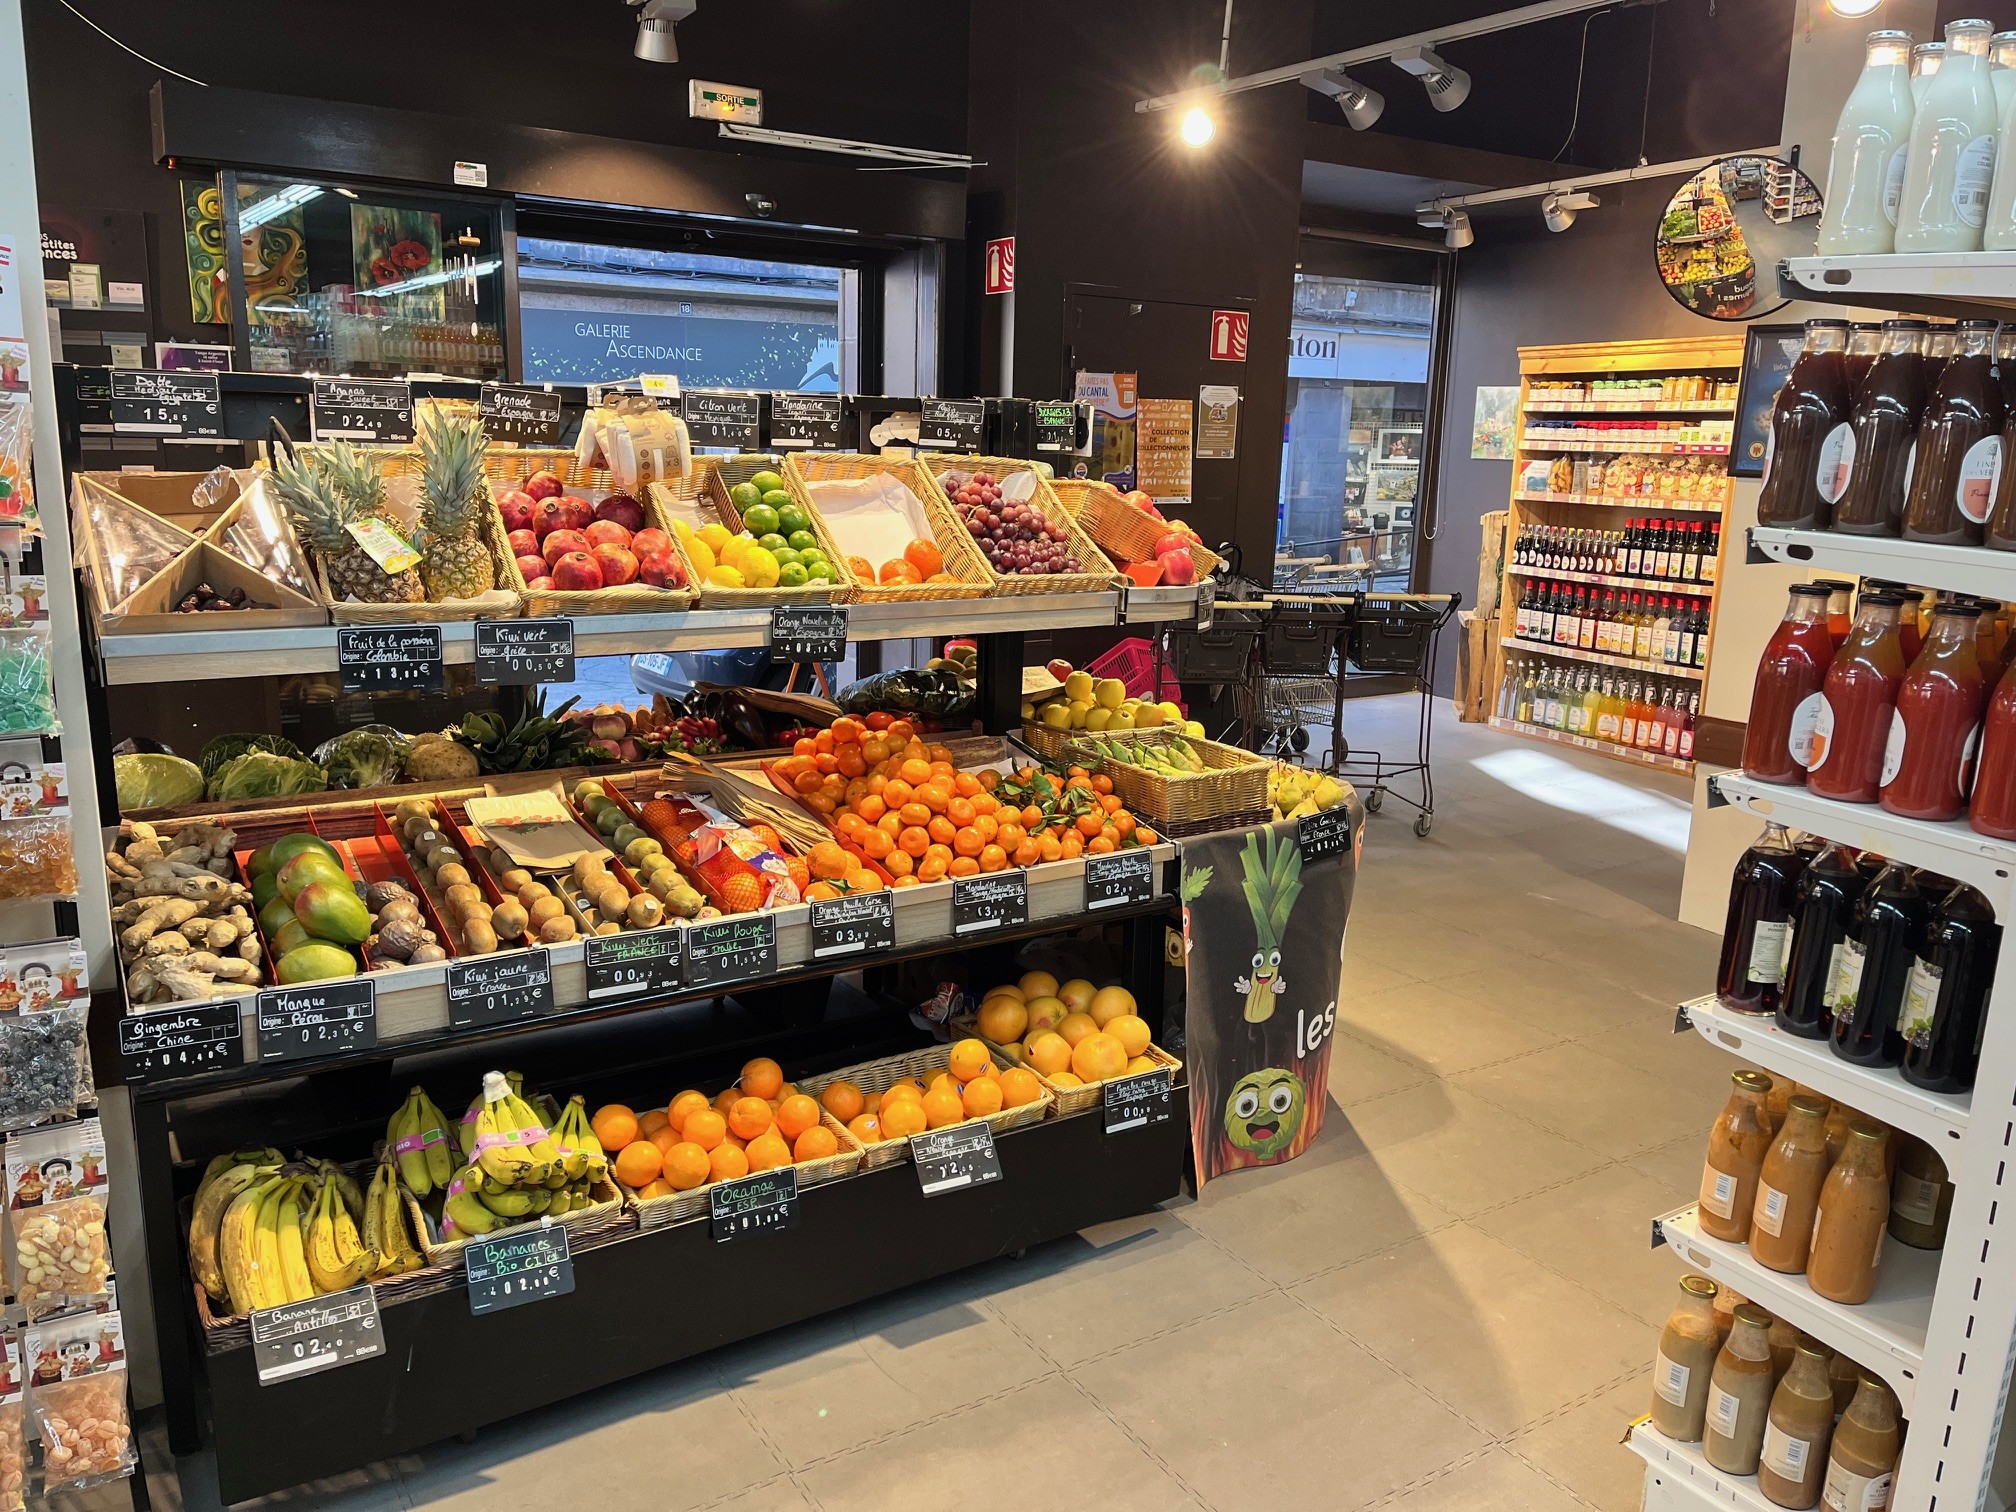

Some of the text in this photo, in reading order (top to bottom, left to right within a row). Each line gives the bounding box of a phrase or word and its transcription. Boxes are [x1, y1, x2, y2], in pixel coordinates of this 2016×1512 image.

[716, 93, 744, 105] SORTIE
[680, 304, 691, 314] 18
[574, 322, 630, 339] GALERIE
[605, 339, 702, 361] ASCENDANCE
[1078, 387, 1109, 397] DU CANTAL
[206, 404, 217, 415] €
[699, 400, 725, 412] Citron
[782, 399, 823, 410] Mandarine
[398, 411, 408, 422] €
[830, 422, 838, 432] €
[673, 458, 680, 467] 3
[495, 628, 520, 643] Kiwi
[376, 636, 386, 648] de
[342, 649, 409, 663] Origine: Colombie
[480, 646, 499, 656] Origine:
[419, 662, 429, 673] €
[555, 658, 564, 668] €
[882, 917, 891, 928] €
[617, 945, 657, 960] FRANCE
[759, 949, 768, 959] €
[669, 955, 679, 967] €
[464, 964, 528, 984] Kiwi jaune
[452, 988, 472, 998] Origine:
[532, 988, 542, 998] €
[277, 994, 325, 1011] Mangue
[262, 1018, 285, 1028] Origine:
[353, 1021, 364, 1032] €
[1296, 1001, 1336, 1059] les
[123, 1035, 194, 1052] Origine: Chine
[215, 1042, 227, 1053] €
[1161, 1093, 1169, 1102] €
[984, 1148, 993, 1159] €
[470, 1268, 491, 1279] Origine:
[496, 1260, 518, 1275] Bio
[548, 1265, 559, 1278] €
[271, 1307, 320, 1324] Banane
[362, 1316, 377, 1329] €
